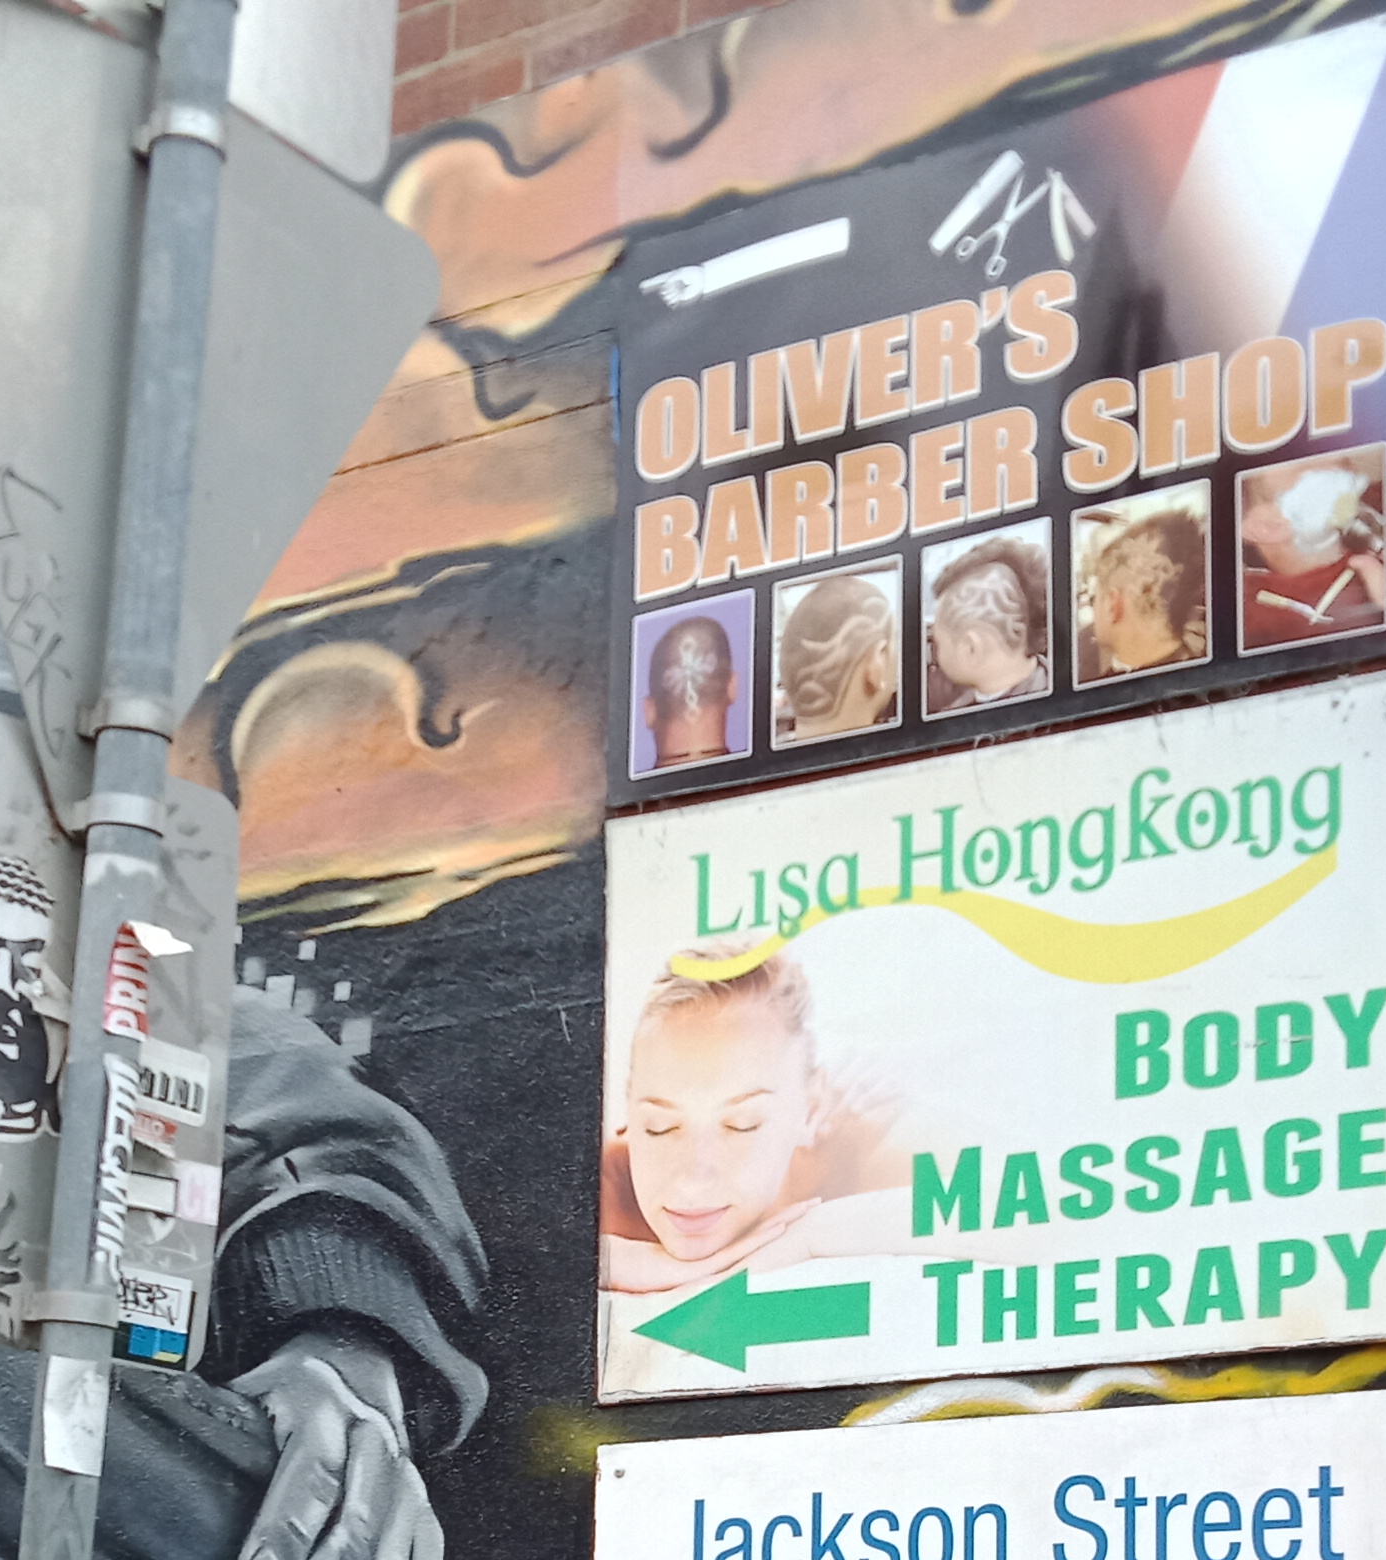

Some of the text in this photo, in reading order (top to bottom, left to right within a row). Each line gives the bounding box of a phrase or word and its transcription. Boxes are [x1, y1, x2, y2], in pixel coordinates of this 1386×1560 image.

[635, 269, 1079, 483] OLIVER'S
[634, 406, 1039, 603] BARBER
[892, 761, 1344, 903] Hongkong
